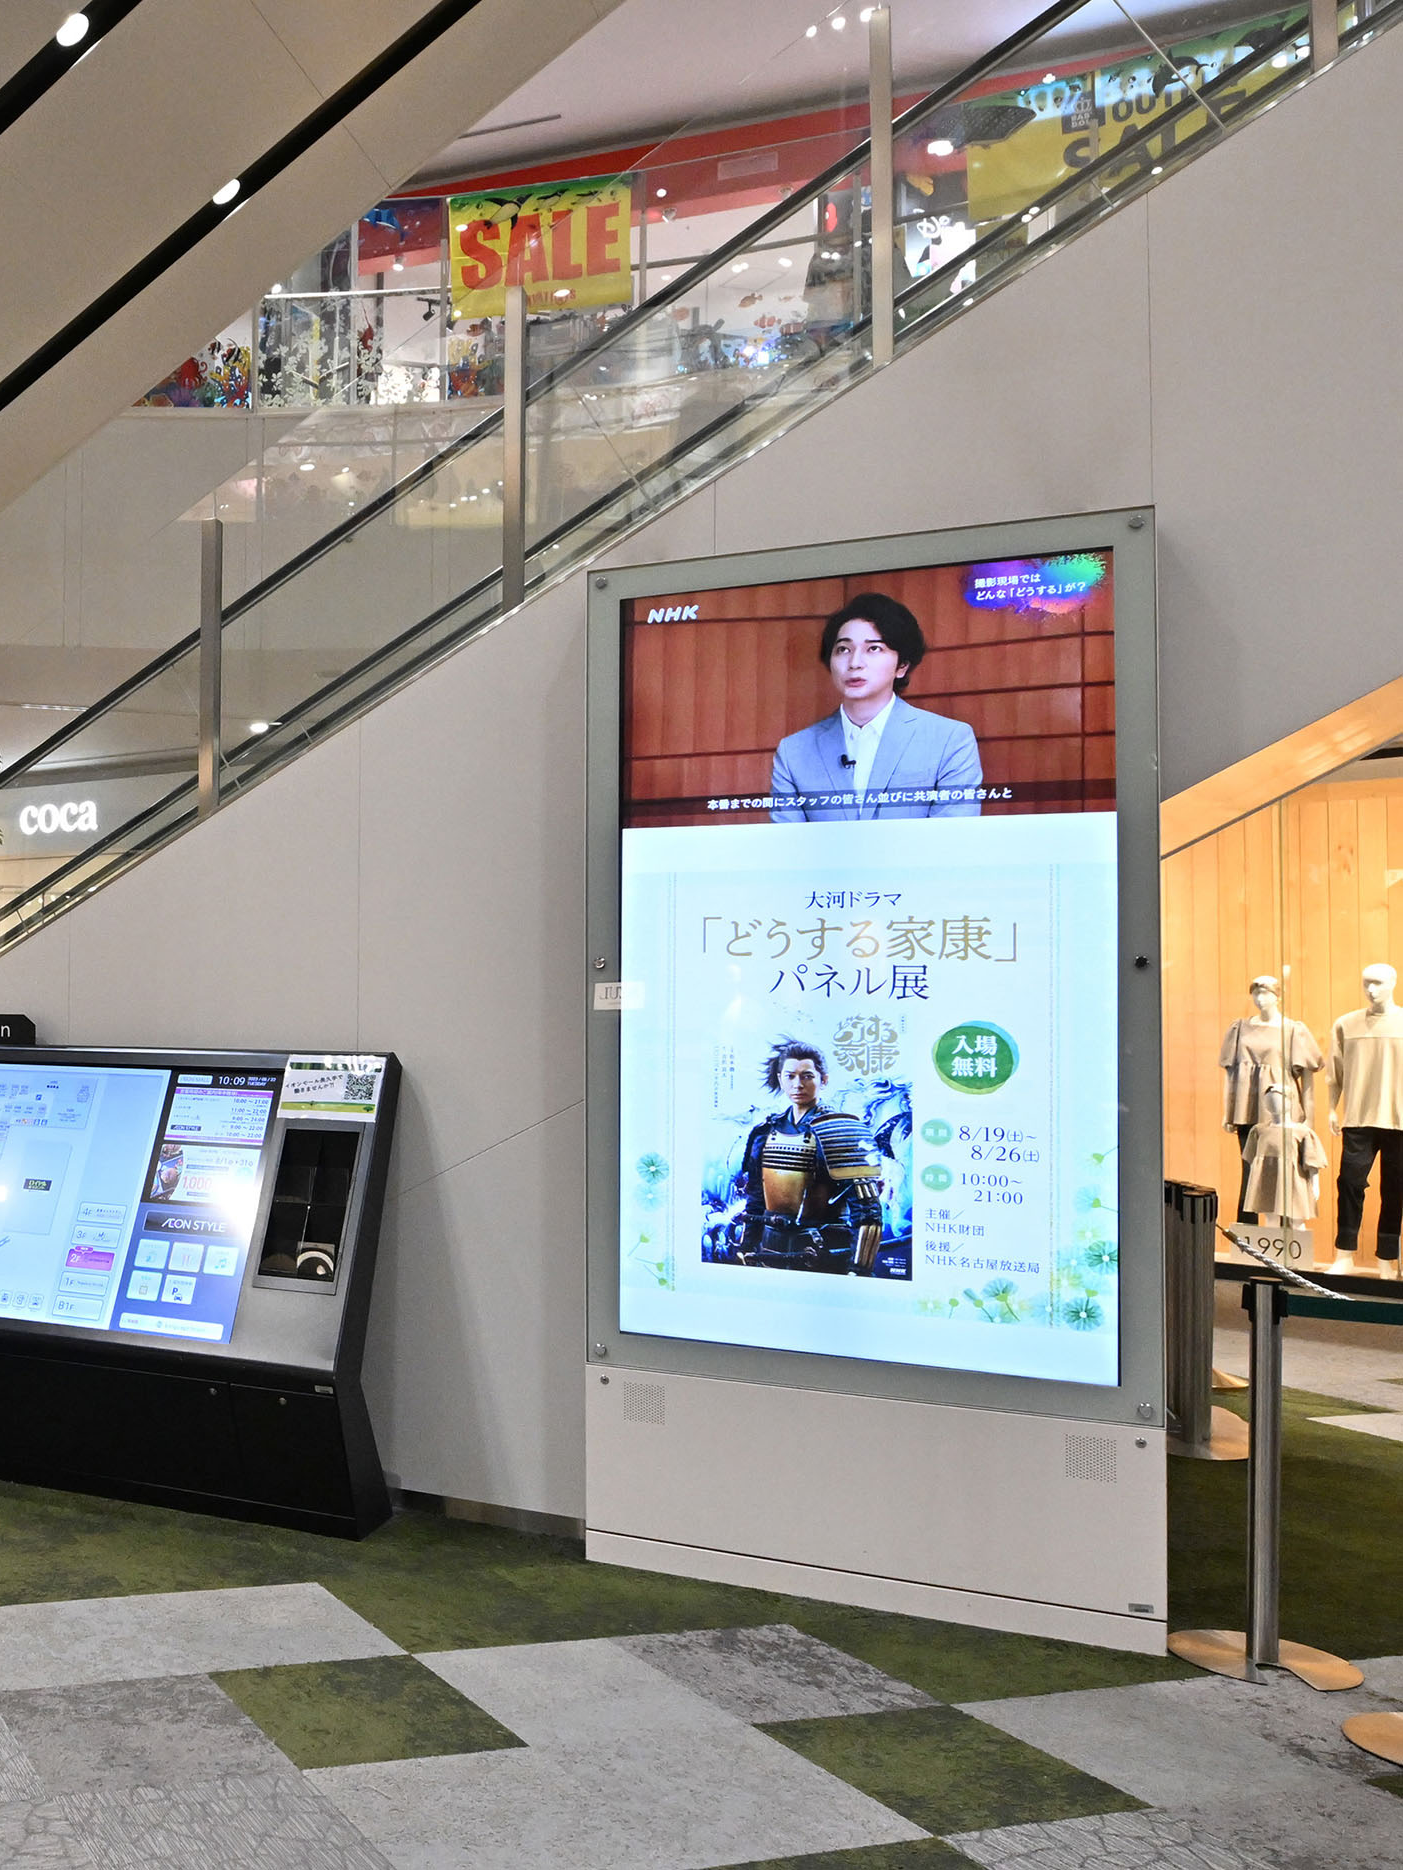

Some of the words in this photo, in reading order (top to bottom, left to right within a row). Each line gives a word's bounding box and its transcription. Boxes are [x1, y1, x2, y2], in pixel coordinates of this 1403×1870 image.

[460, 201, 621, 290] SALE
[647, 604, 699, 624] NHK
[19, 800, 99, 836] coca
[805, 890, 902, 910] 大河ドラマ
[703, 914, 1017, 962] 「どうする家康」
[769, 963, 931, 1000] パネル展
[952, 1035, 997, 1056] 入場
[951, 1056, 998, 1078] 無料
[219, 1076, 246, 1086] 10:09
[970, 1144, 1040, 1163] 8/26(土)
[974, 1189, 1023, 1205] 21:00
[192, 1219, 227, 1232] STYLE
[925, 1222, 985, 1237] NHK財団
[925, 1254, 1040, 1274] NHK名古屋放送局
[57, 1300, 75, 1311] B1F
